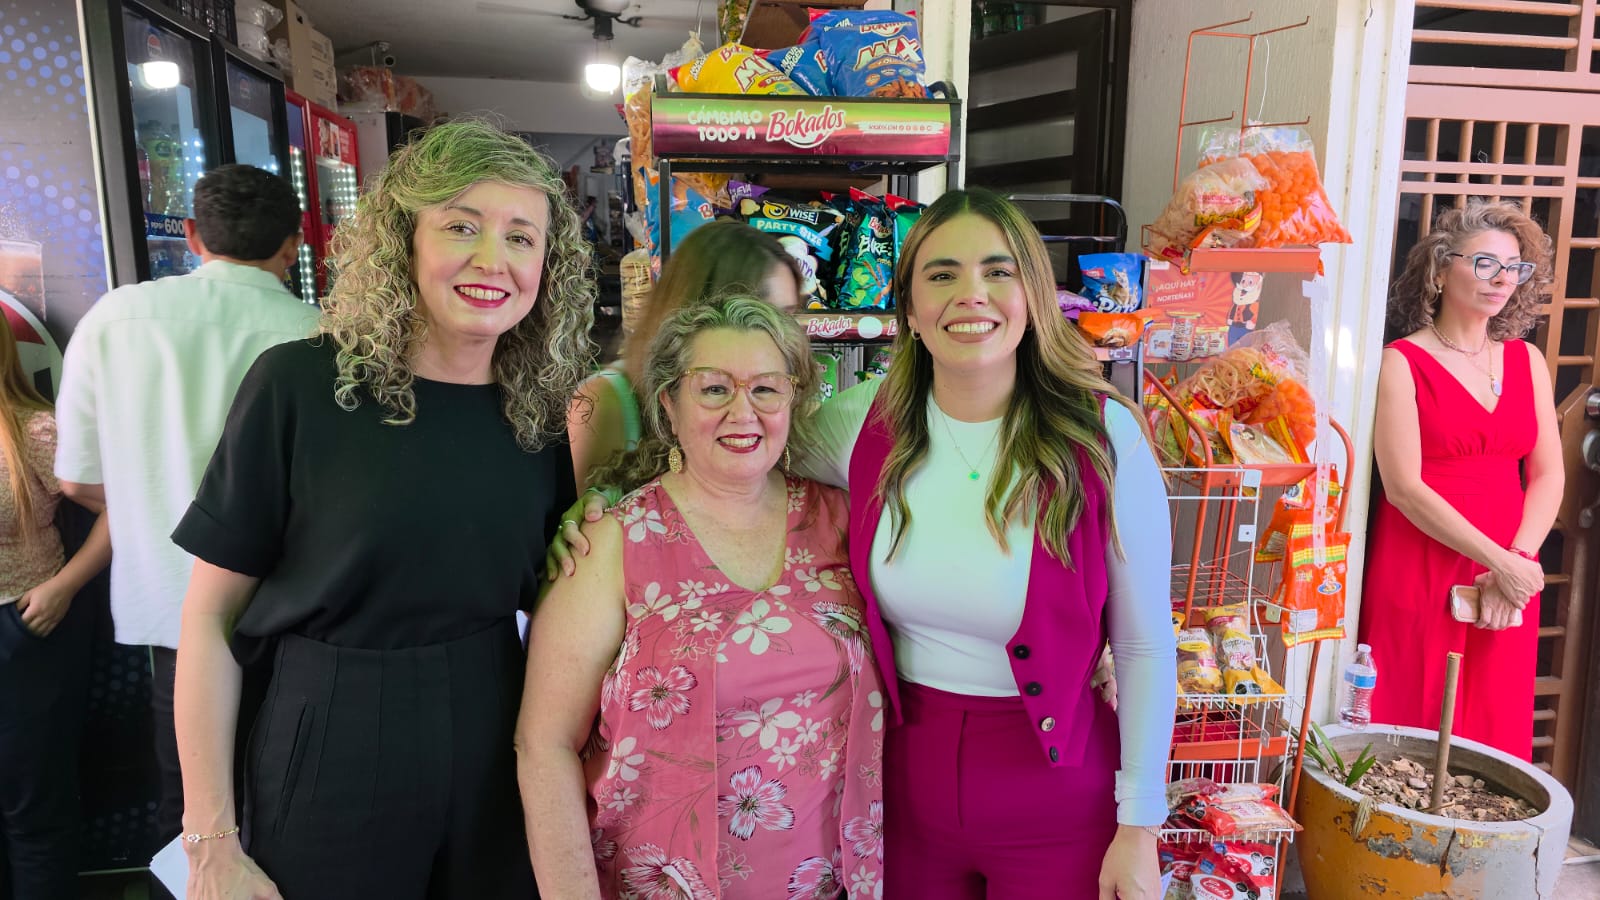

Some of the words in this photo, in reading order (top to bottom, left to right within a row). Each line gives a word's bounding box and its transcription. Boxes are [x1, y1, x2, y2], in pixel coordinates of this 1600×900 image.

[853, 35, 922, 72] MIX
[698, 126, 740, 142] TODO
[745, 126, 756, 140] A
[767, 105, 846, 145] Bokados
[789, 208, 817, 222] WISE
[757, 220, 797, 233] PARTY
[798, 225, 823, 247] SIZE
[1180, 279, 1197, 288] HAY
[807, 316, 852, 336] Bokados
